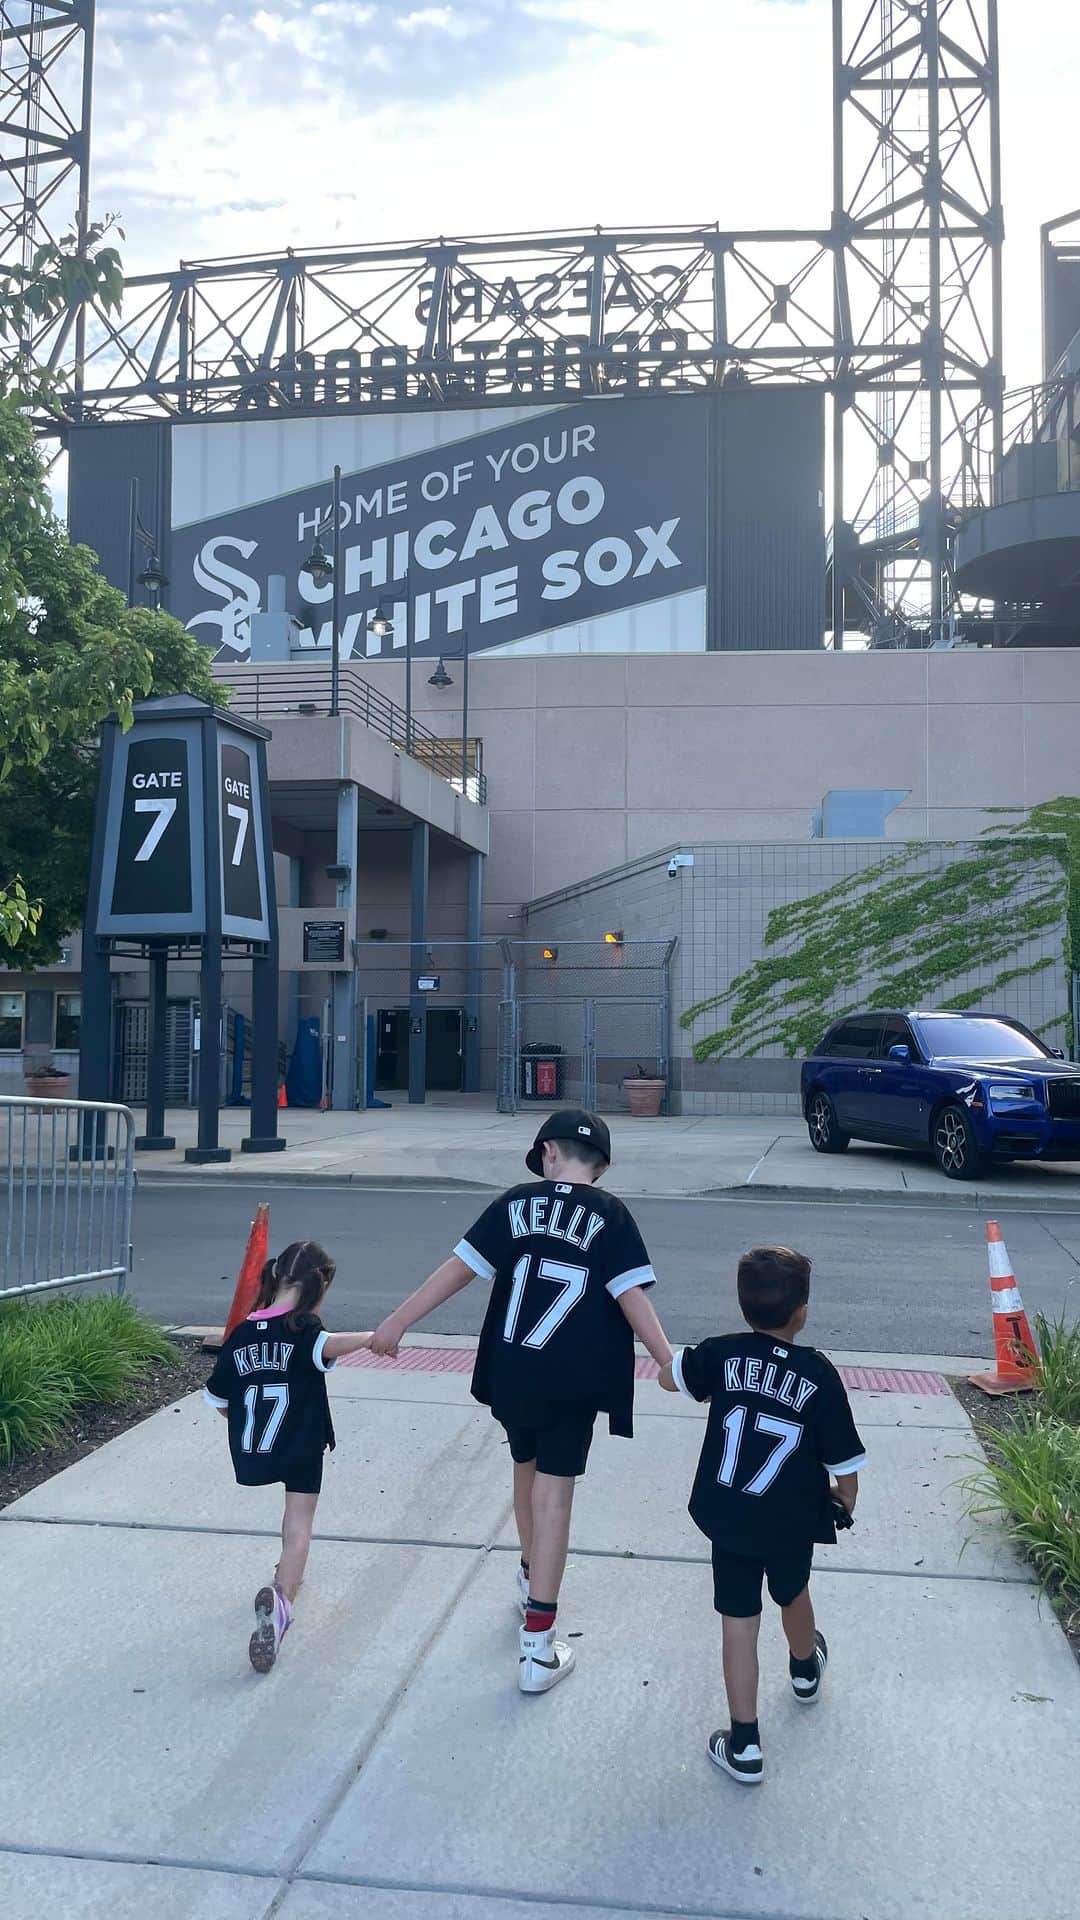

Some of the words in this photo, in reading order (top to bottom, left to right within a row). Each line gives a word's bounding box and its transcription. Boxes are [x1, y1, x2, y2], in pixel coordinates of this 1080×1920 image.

[297, 480, 409, 542] HOME
[421, 461, 474, 501] OF
[486, 424, 596, 482] YOUR
[298, 476, 606, 604] CHICAGO
[541, 517, 683, 601] SOX
[132, 771, 183, 790] GATE
[224, 777, 250, 800] GATE
[134, 798, 177, 862] 7
[227, 803, 249, 866] 7
[508, 1197, 606, 1252] KELLY
[503, 1254, 590, 1350] 17
[233, 1342, 295, 1377] KELLY
[724, 1357, 819, 1413] KELLY
[241, 1383, 290, 1454] 17
[717, 1405, 804, 1496] 17
